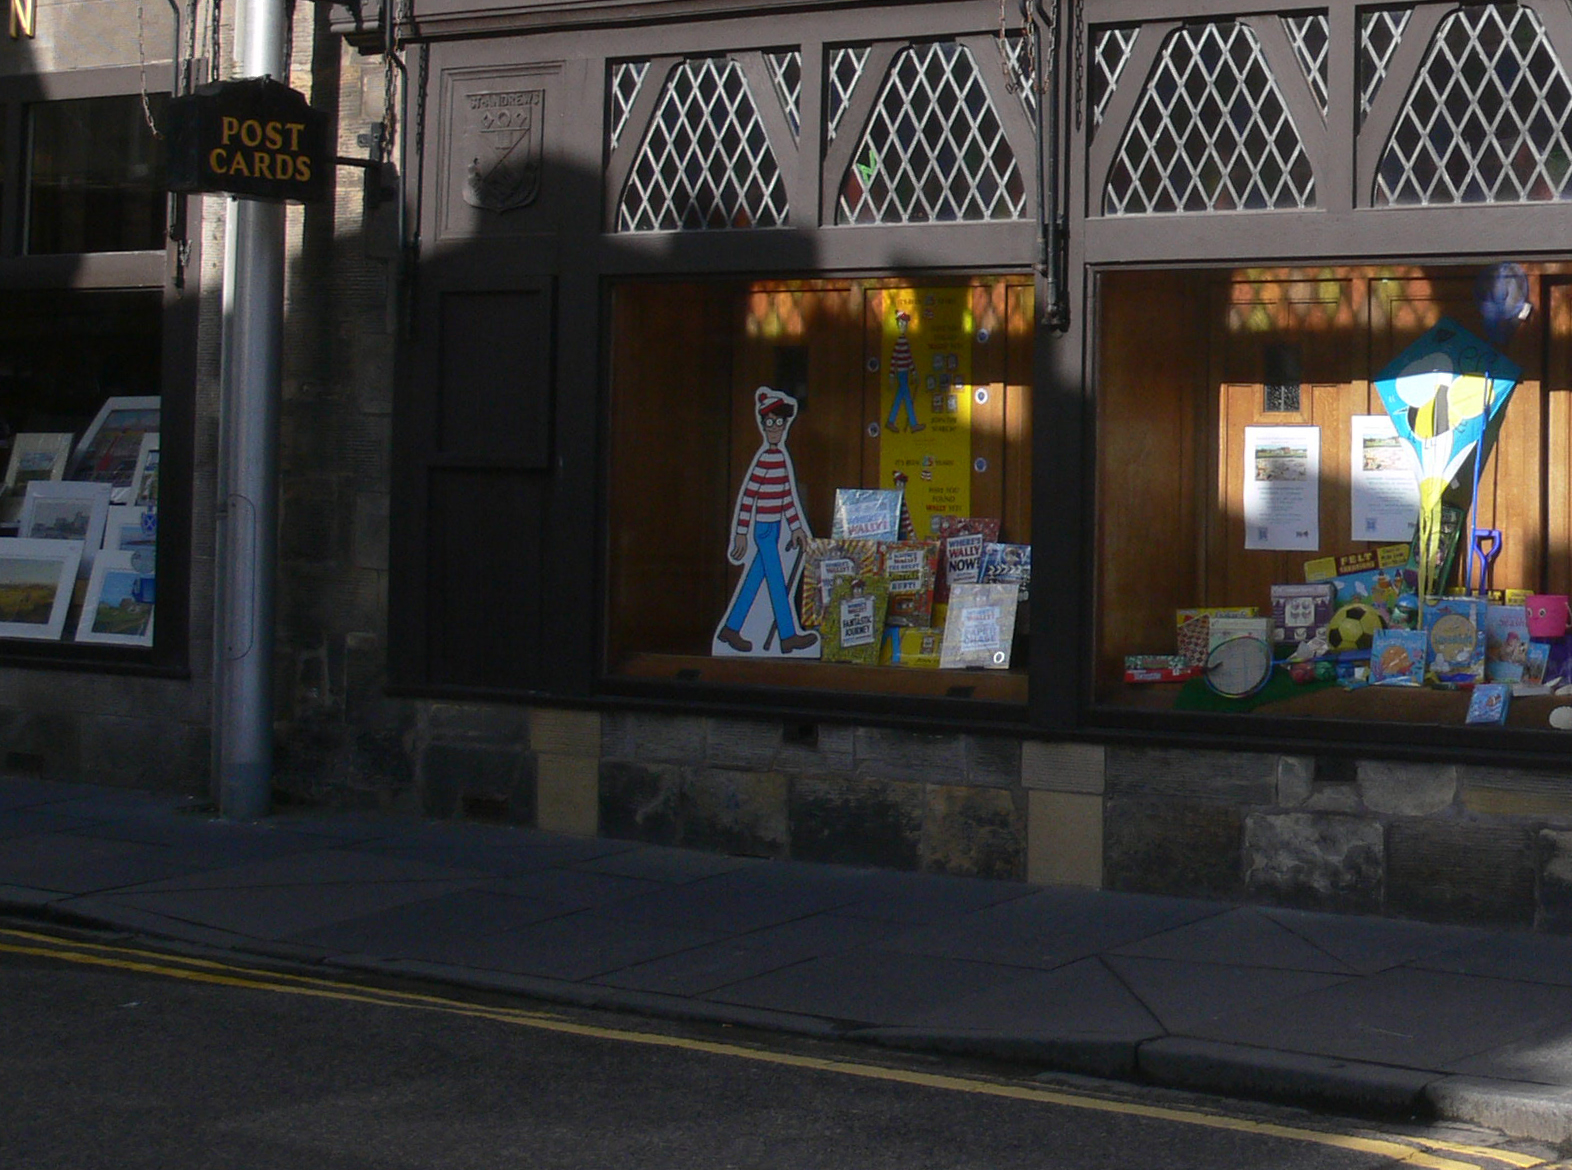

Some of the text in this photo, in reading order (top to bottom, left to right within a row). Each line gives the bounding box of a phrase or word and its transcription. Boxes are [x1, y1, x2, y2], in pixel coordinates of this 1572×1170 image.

[221, 116, 306, 151] POST
[209, 148, 312, 182] CARDS
[949, 545, 981, 558] WALLY
[1340, 552, 1373, 566] FELT
